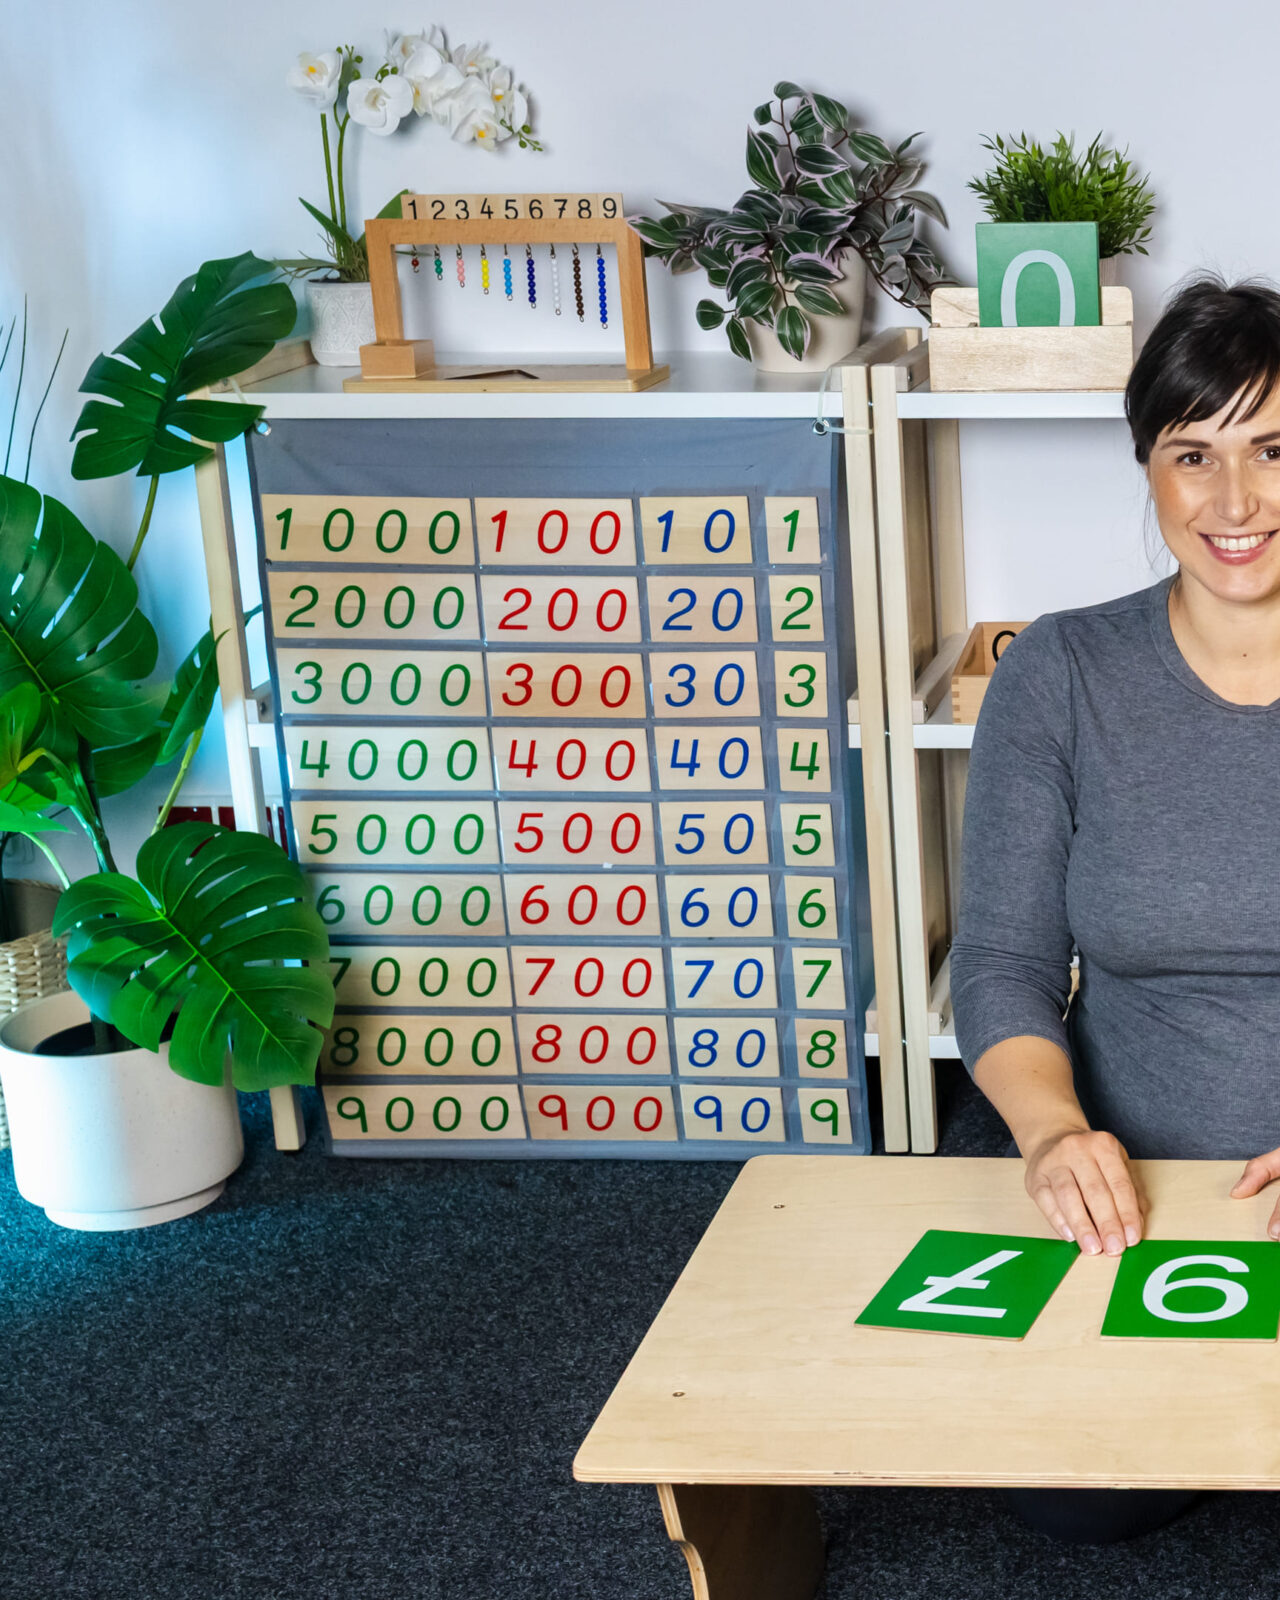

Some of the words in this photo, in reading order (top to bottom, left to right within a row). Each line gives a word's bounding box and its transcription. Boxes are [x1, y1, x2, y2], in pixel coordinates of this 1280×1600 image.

[408, 201, 417, 219] 1
[432, 201, 445, 219] 2
[455, 201, 469, 219] 3
[480, 198, 493, 219] 4
[505, 200, 518, 219] 5
[529, 199, 543, 219] 6
[554, 200, 567, 219] 7
[578, 199, 591, 218] 8
[603, 198, 616, 218] 9
[277, 509, 459, 553] 1000
[492, 510, 620, 554] 100
[658, 510, 735, 553] 10
[784, 510, 799, 551] 1
[286, 586, 463, 629] 2000
[499, 588, 626, 632] 200
[663, 589, 742, 631] 20
[782, 588, 813, 629] 2
[292, 662, 470, 706] 3000
[502, 663, 631, 708] 300
[666, 664, 744, 706] 30
[785, 664, 815, 707] 3
[300, 740, 477, 780] 4000
[509, 739, 635, 780] 400
[671, 738, 748, 778] 40
[791, 742, 819, 779] 4
[309, 814, 483, 855] 5000
[515, 813, 640, 853] 500
[676, 814, 753, 854] 50
[793, 815, 820, 855] 5
[318, 885, 490, 925] 6000
[521, 885, 646, 925] 600
[681, 887, 757, 927] 60
[799, 889, 825, 927] 6
[526, 958, 651, 997] 700
[685, 959, 763, 998] 70
[804, 960, 831, 997] 7
[330, 1028, 500, 1067] 8000
[532, 1024, 656, 1065] 800
[689, 1029, 765, 1067] 80
[807, 1031, 836, 1068] 8
[337, 1096, 508, 1132] 9000
[538, 1095, 662, 1132] 900
[694, 1096, 770, 1132] 90
[811, 1100, 837, 1135] 9
